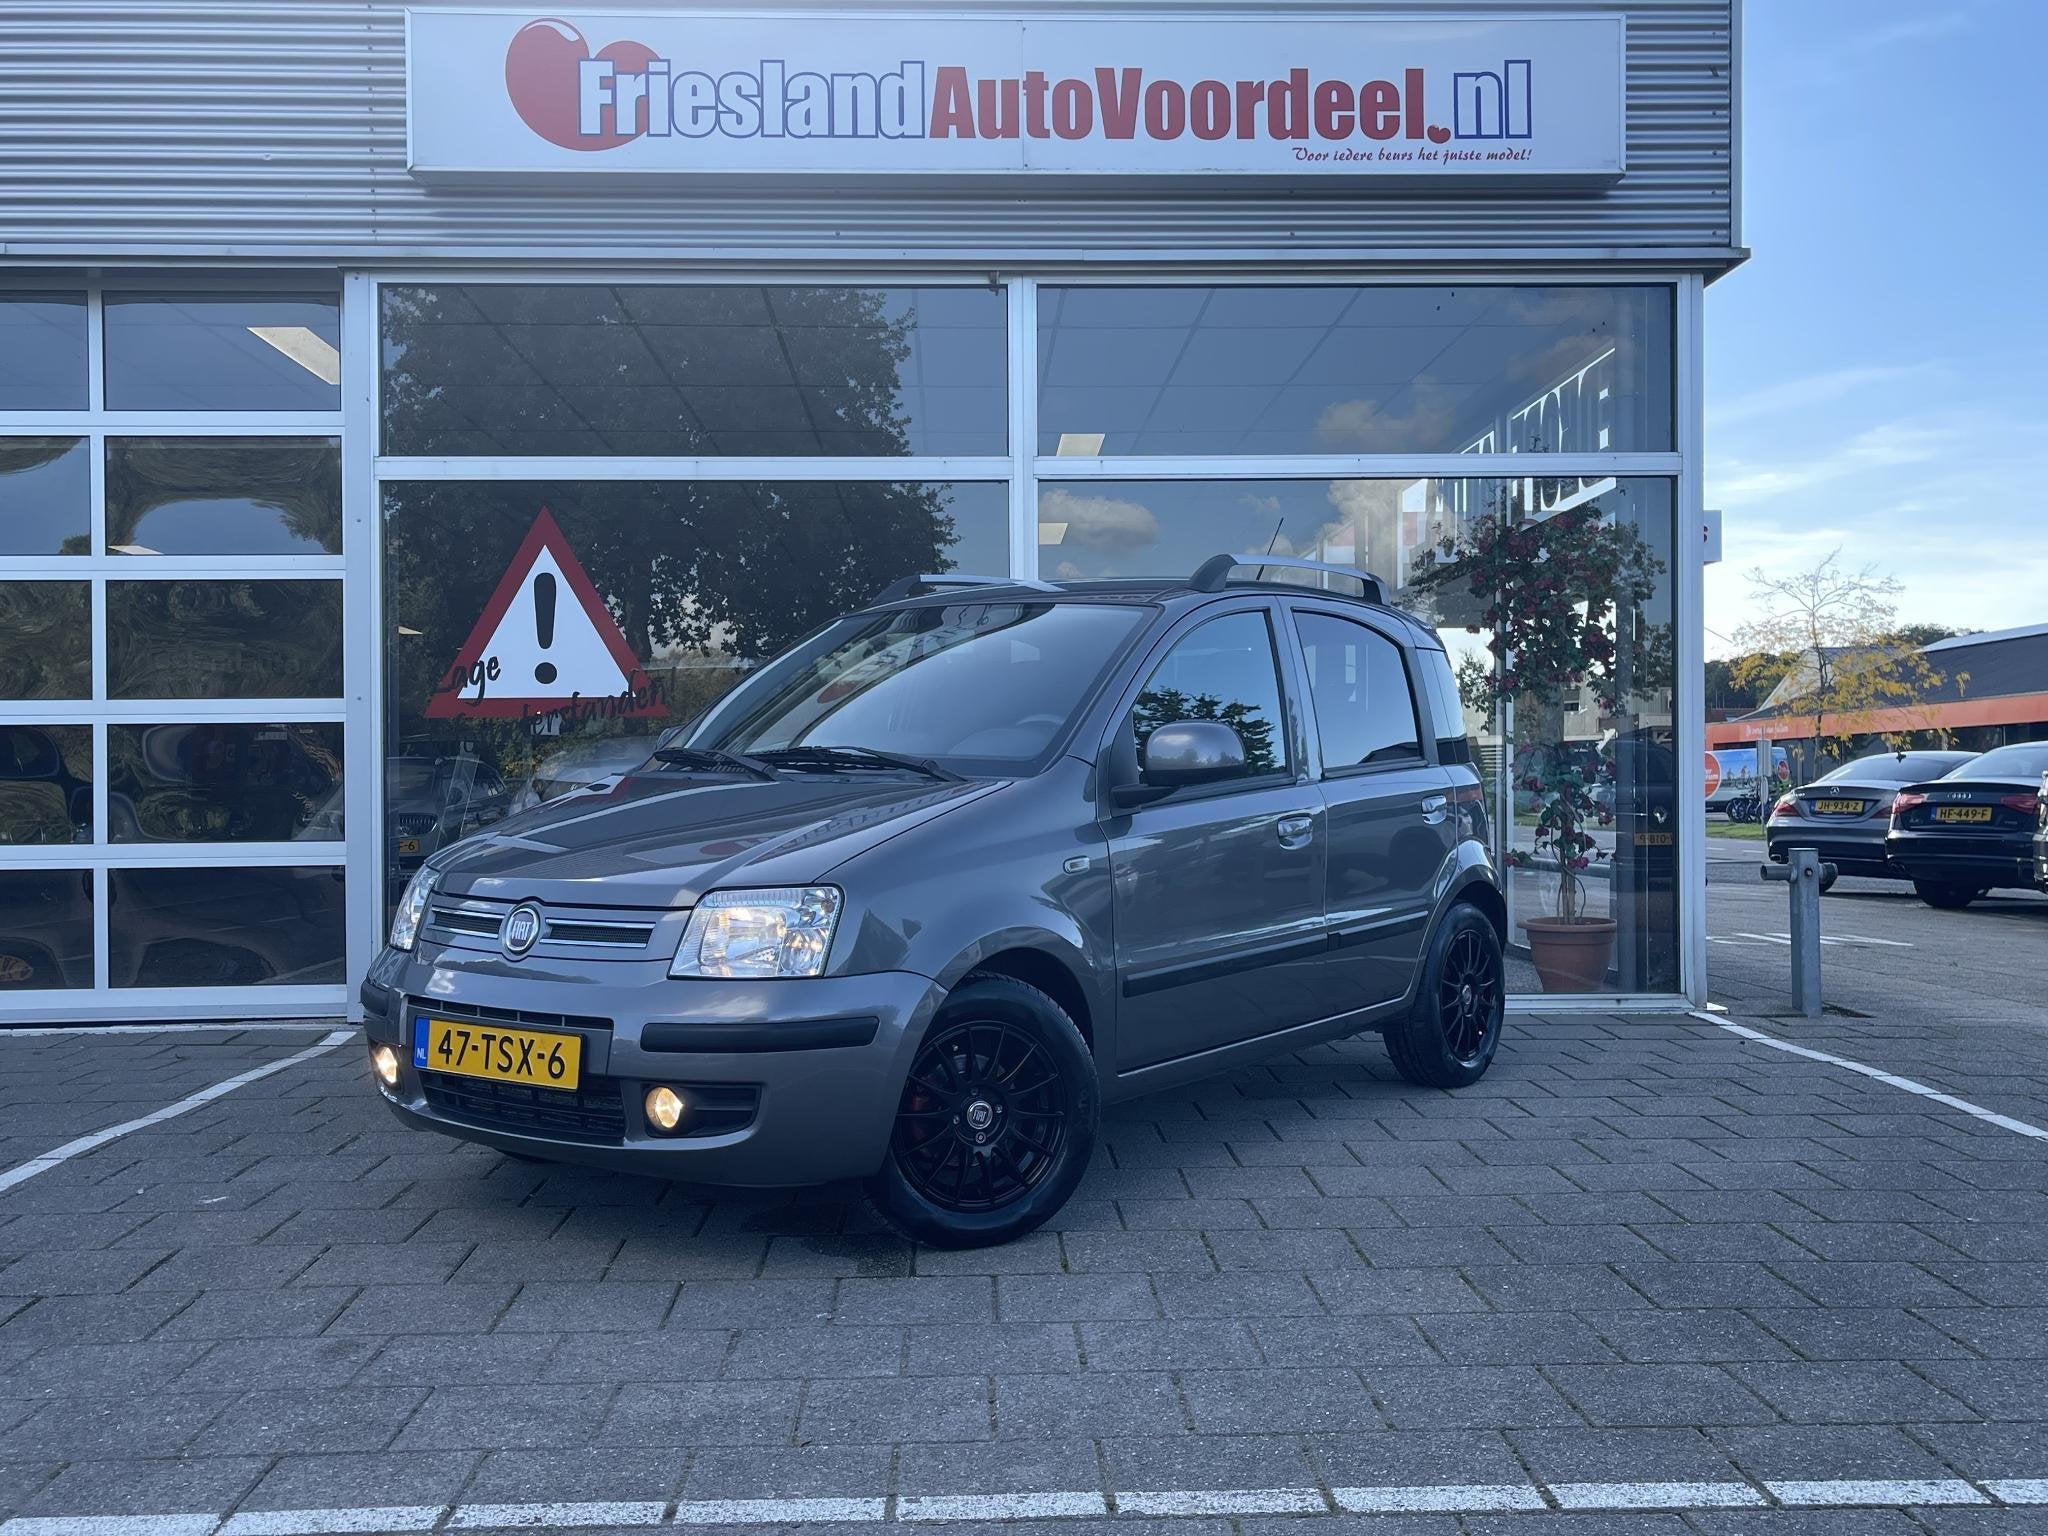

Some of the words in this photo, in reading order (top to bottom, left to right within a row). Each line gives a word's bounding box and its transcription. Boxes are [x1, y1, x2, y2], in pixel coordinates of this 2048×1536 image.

[578, 58, 1533, 144] FrieslandAutoVoordeel.nl
[1292, 146, 1330, 162] Voor
[1333, 147, 1374, 162] iedere
[1378, 146, 1414, 162] beurs
[1418, 146, 1439, 162] het
[1442, 147, 1482, 169] juiste
[1486, 147, 1533, 162] model!
[1818, 801, 1860, 811] JH-934-Z
[1939, 808, 1988, 819] HF-449-F
[511, 919, 532, 941] FIAT
[416, 1047, 427, 1060] NL
[438, 1029, 566, 1080] 47-TSX-6
